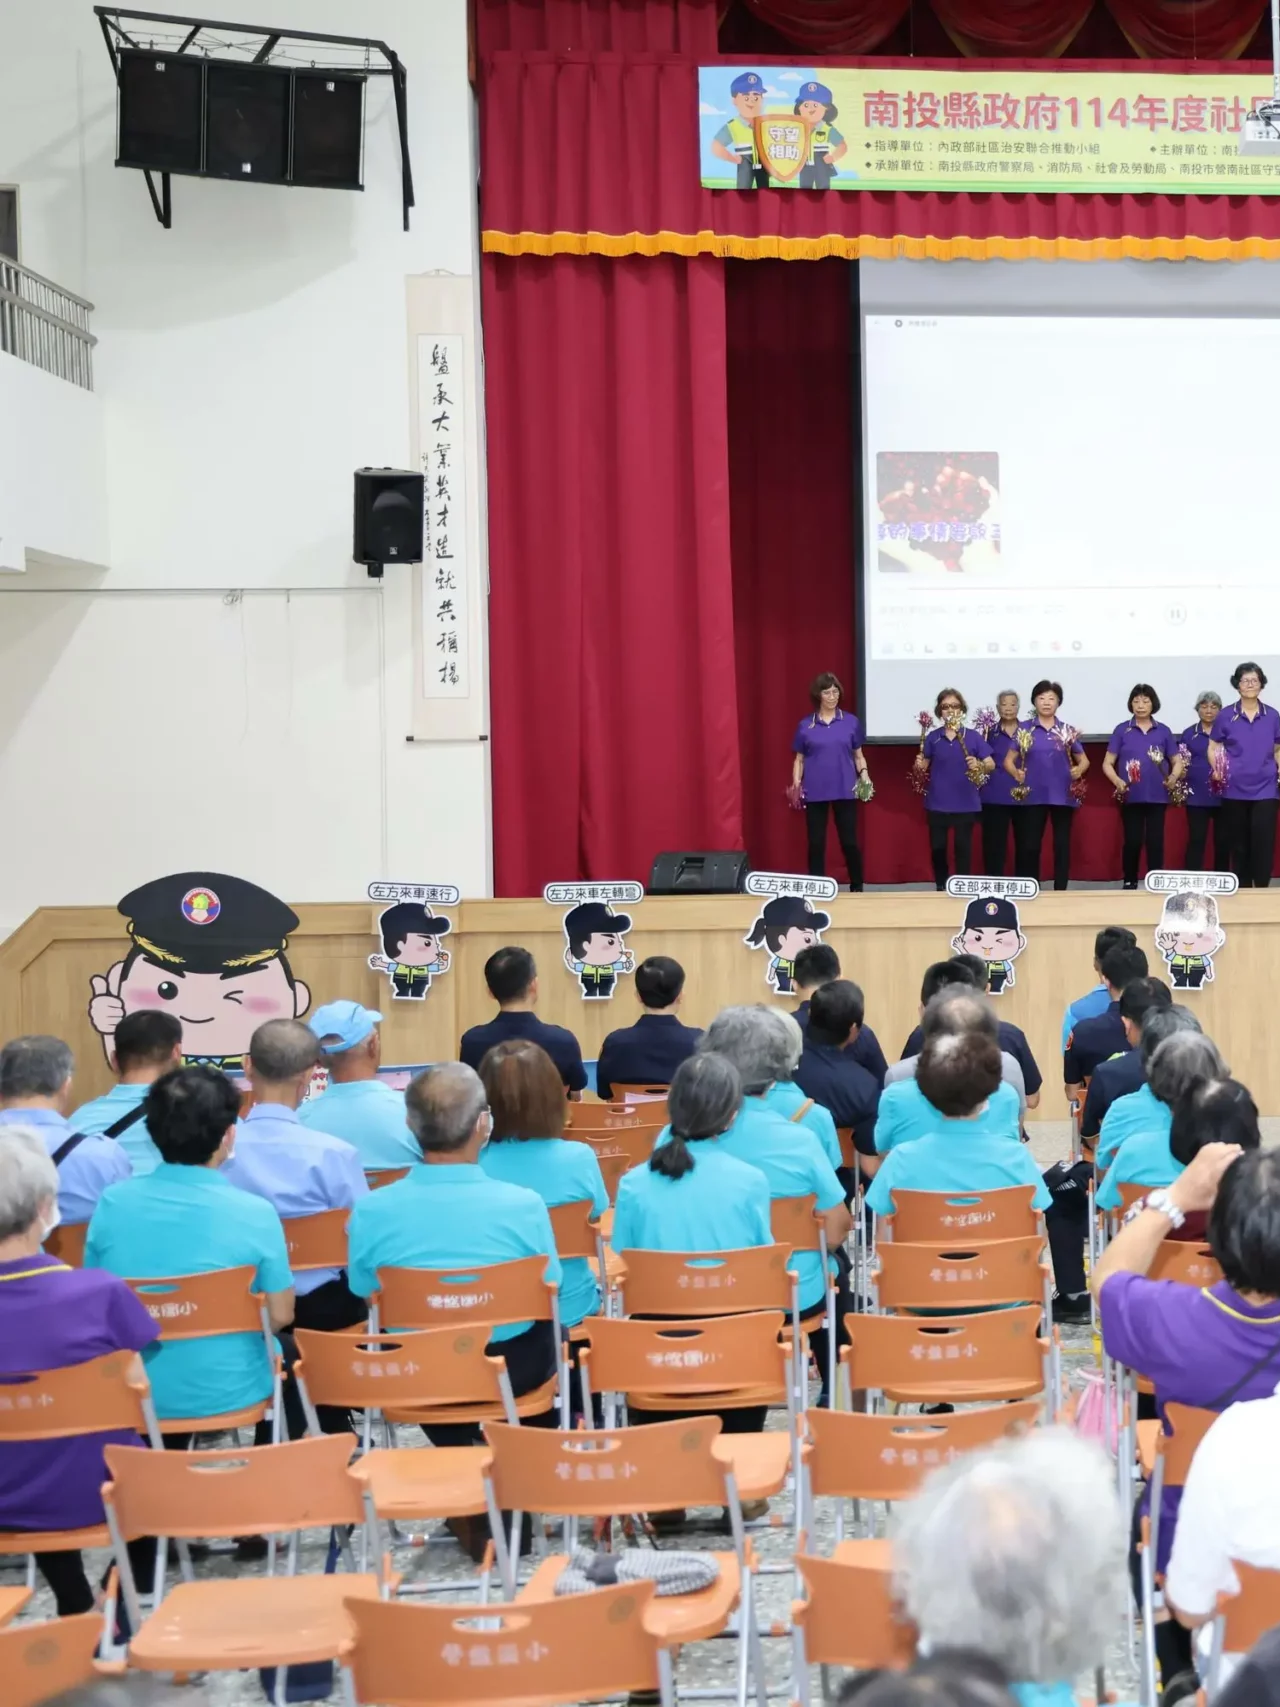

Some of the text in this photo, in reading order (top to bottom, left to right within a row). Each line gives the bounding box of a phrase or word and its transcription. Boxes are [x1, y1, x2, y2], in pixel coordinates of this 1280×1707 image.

[769, 127, 799, 142] 守望
[769, 144, 799, 160] 相助
[753, 879, 829, 895] 左方來車停止
[954, 881, 1031, 895] 全部來車停止
[1153, 875, 1230, 890] 前方來車停止
[373, 885, 452, 900] 左方來車速行
